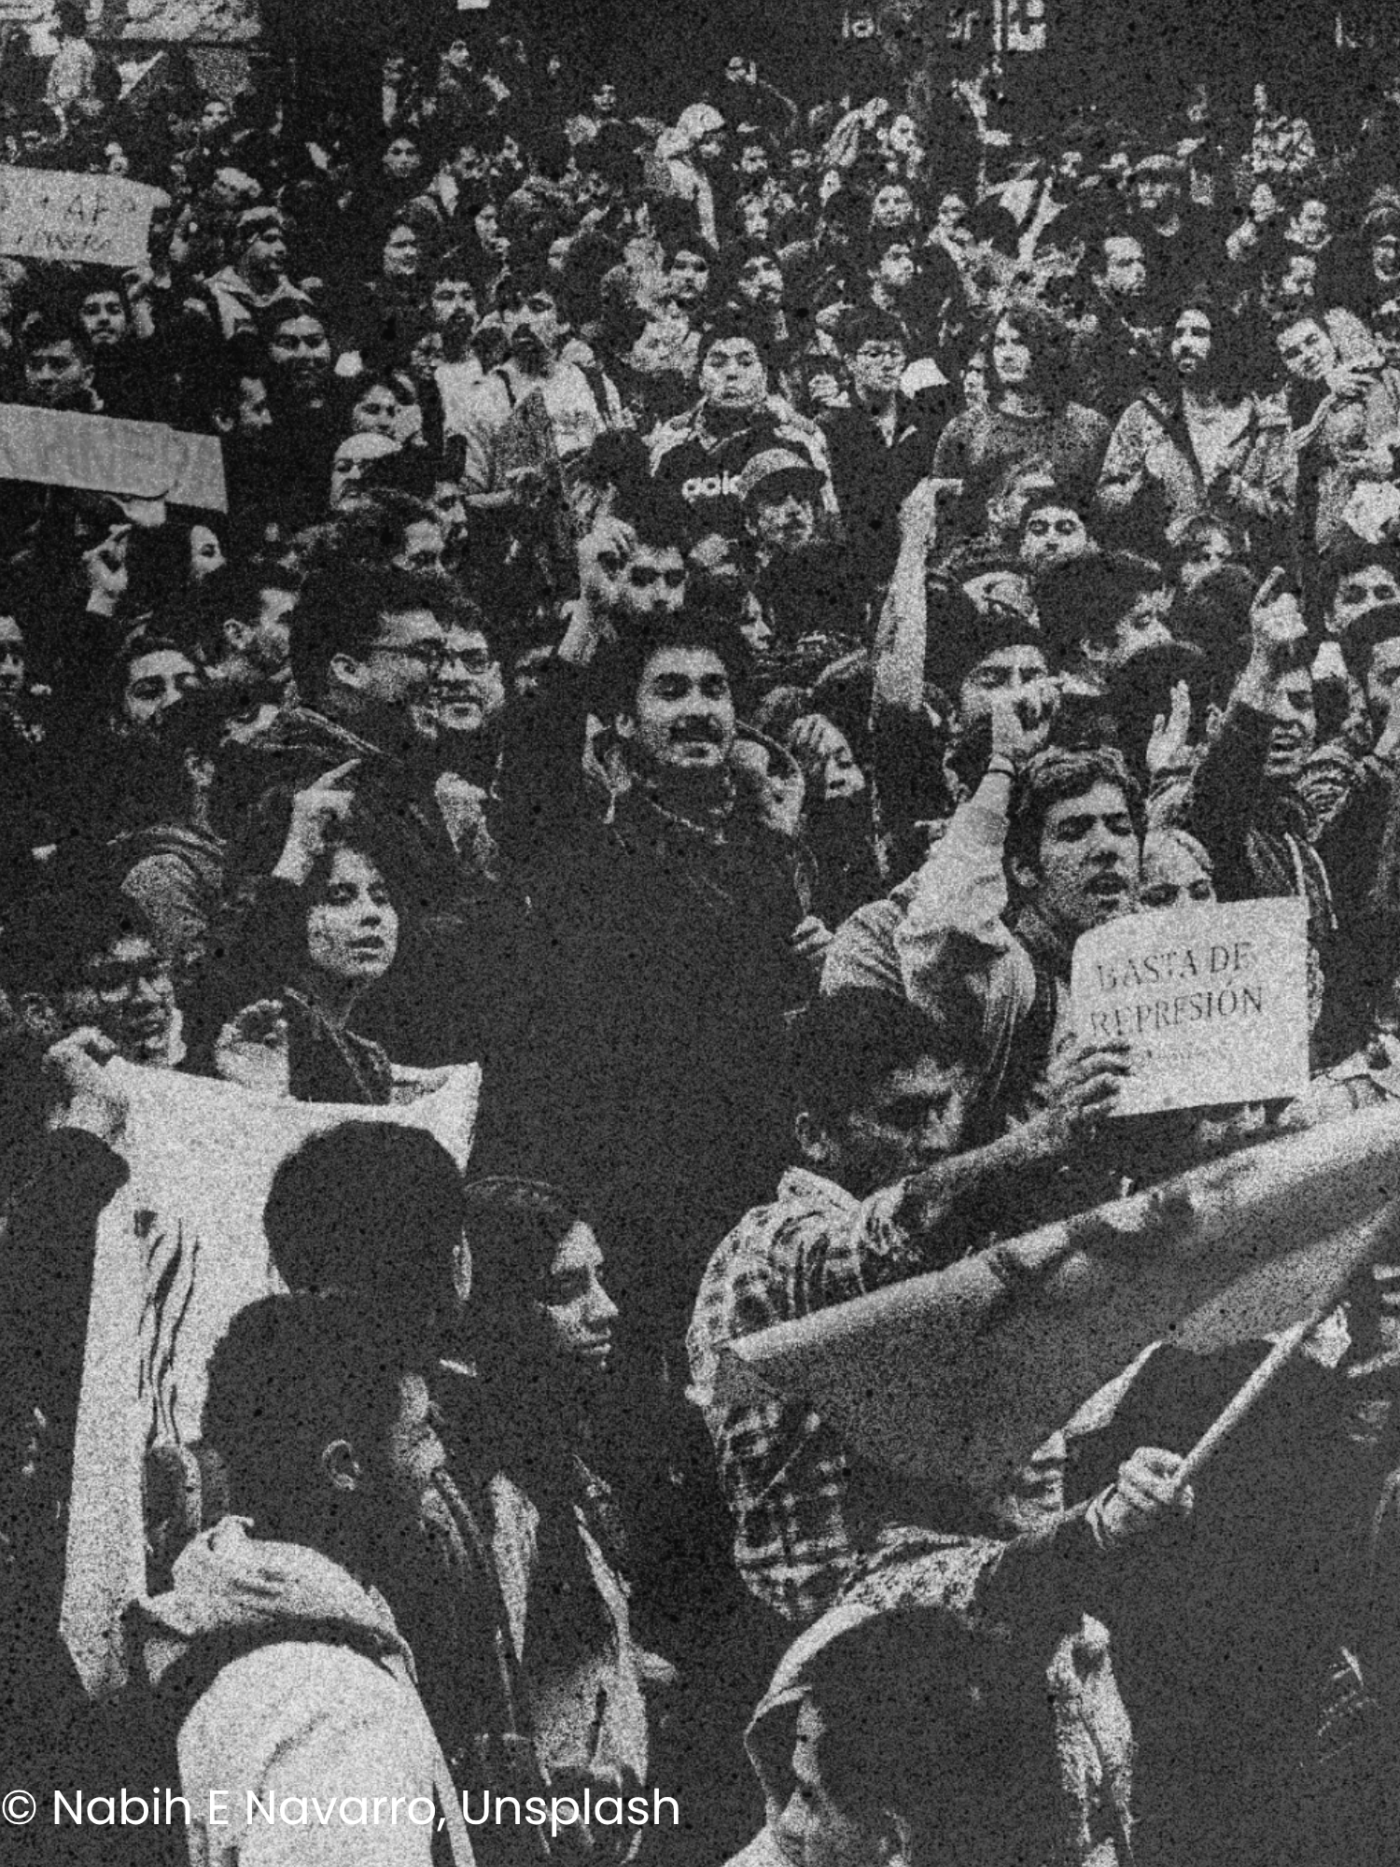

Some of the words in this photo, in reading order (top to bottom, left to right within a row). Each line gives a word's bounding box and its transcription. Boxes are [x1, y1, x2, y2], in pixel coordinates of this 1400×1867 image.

[1096, 950, 1198, 991] BASTA
[1210, 942, 1251, 973] DE
[1090, 980, 1263, 1037] REPRESIÓN
